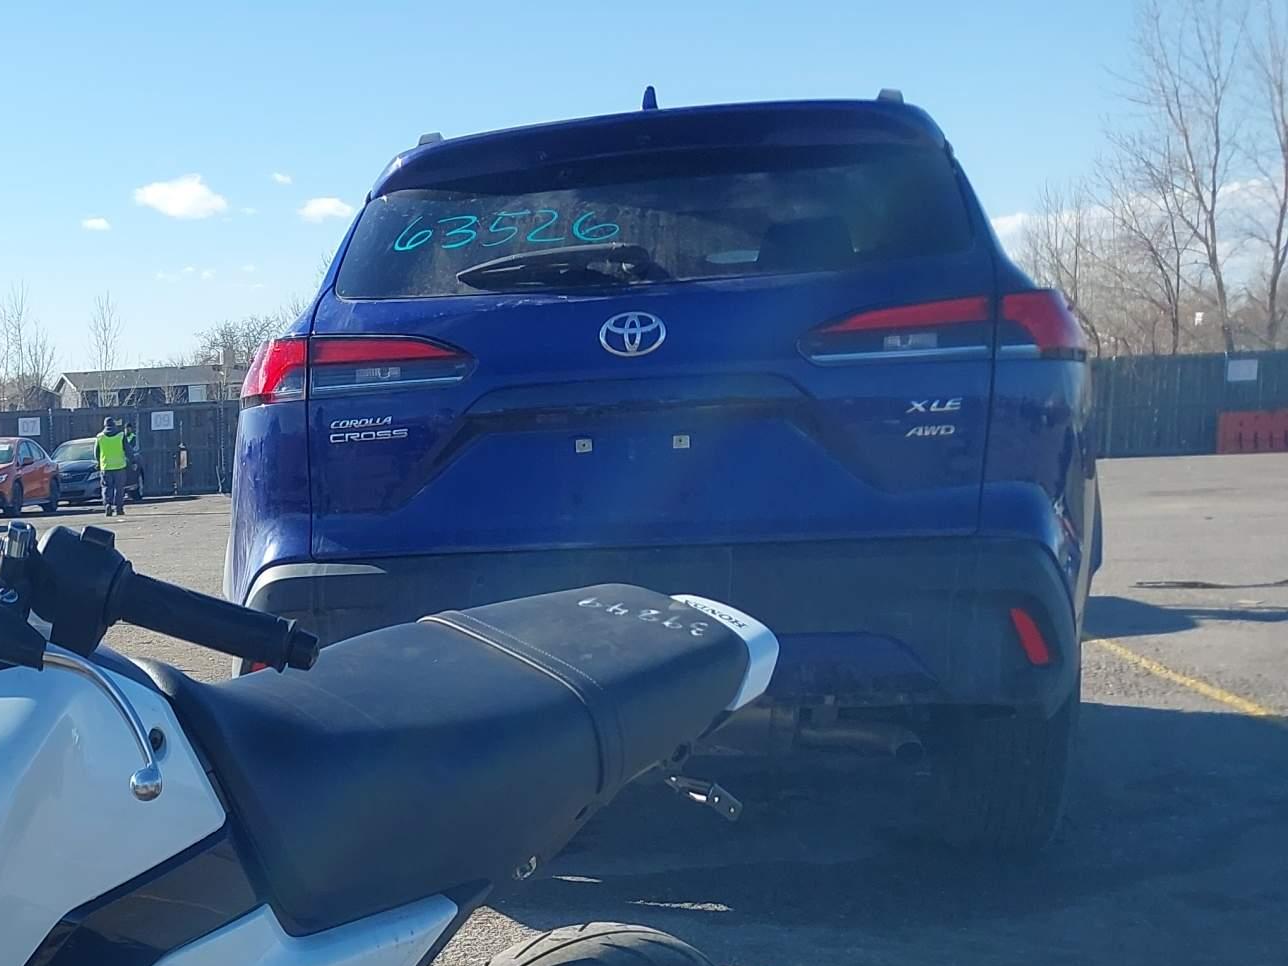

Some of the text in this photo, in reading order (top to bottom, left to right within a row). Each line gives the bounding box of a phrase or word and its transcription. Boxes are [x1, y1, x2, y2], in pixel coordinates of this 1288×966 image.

[394, 209, 620, 251] 63526
[905, 397, 962, 413] XLE
[330, 416, 392, 429] COROLLA
[330, 428, 409, 443] CROSS
[905, 424, 956, 438] AWD
